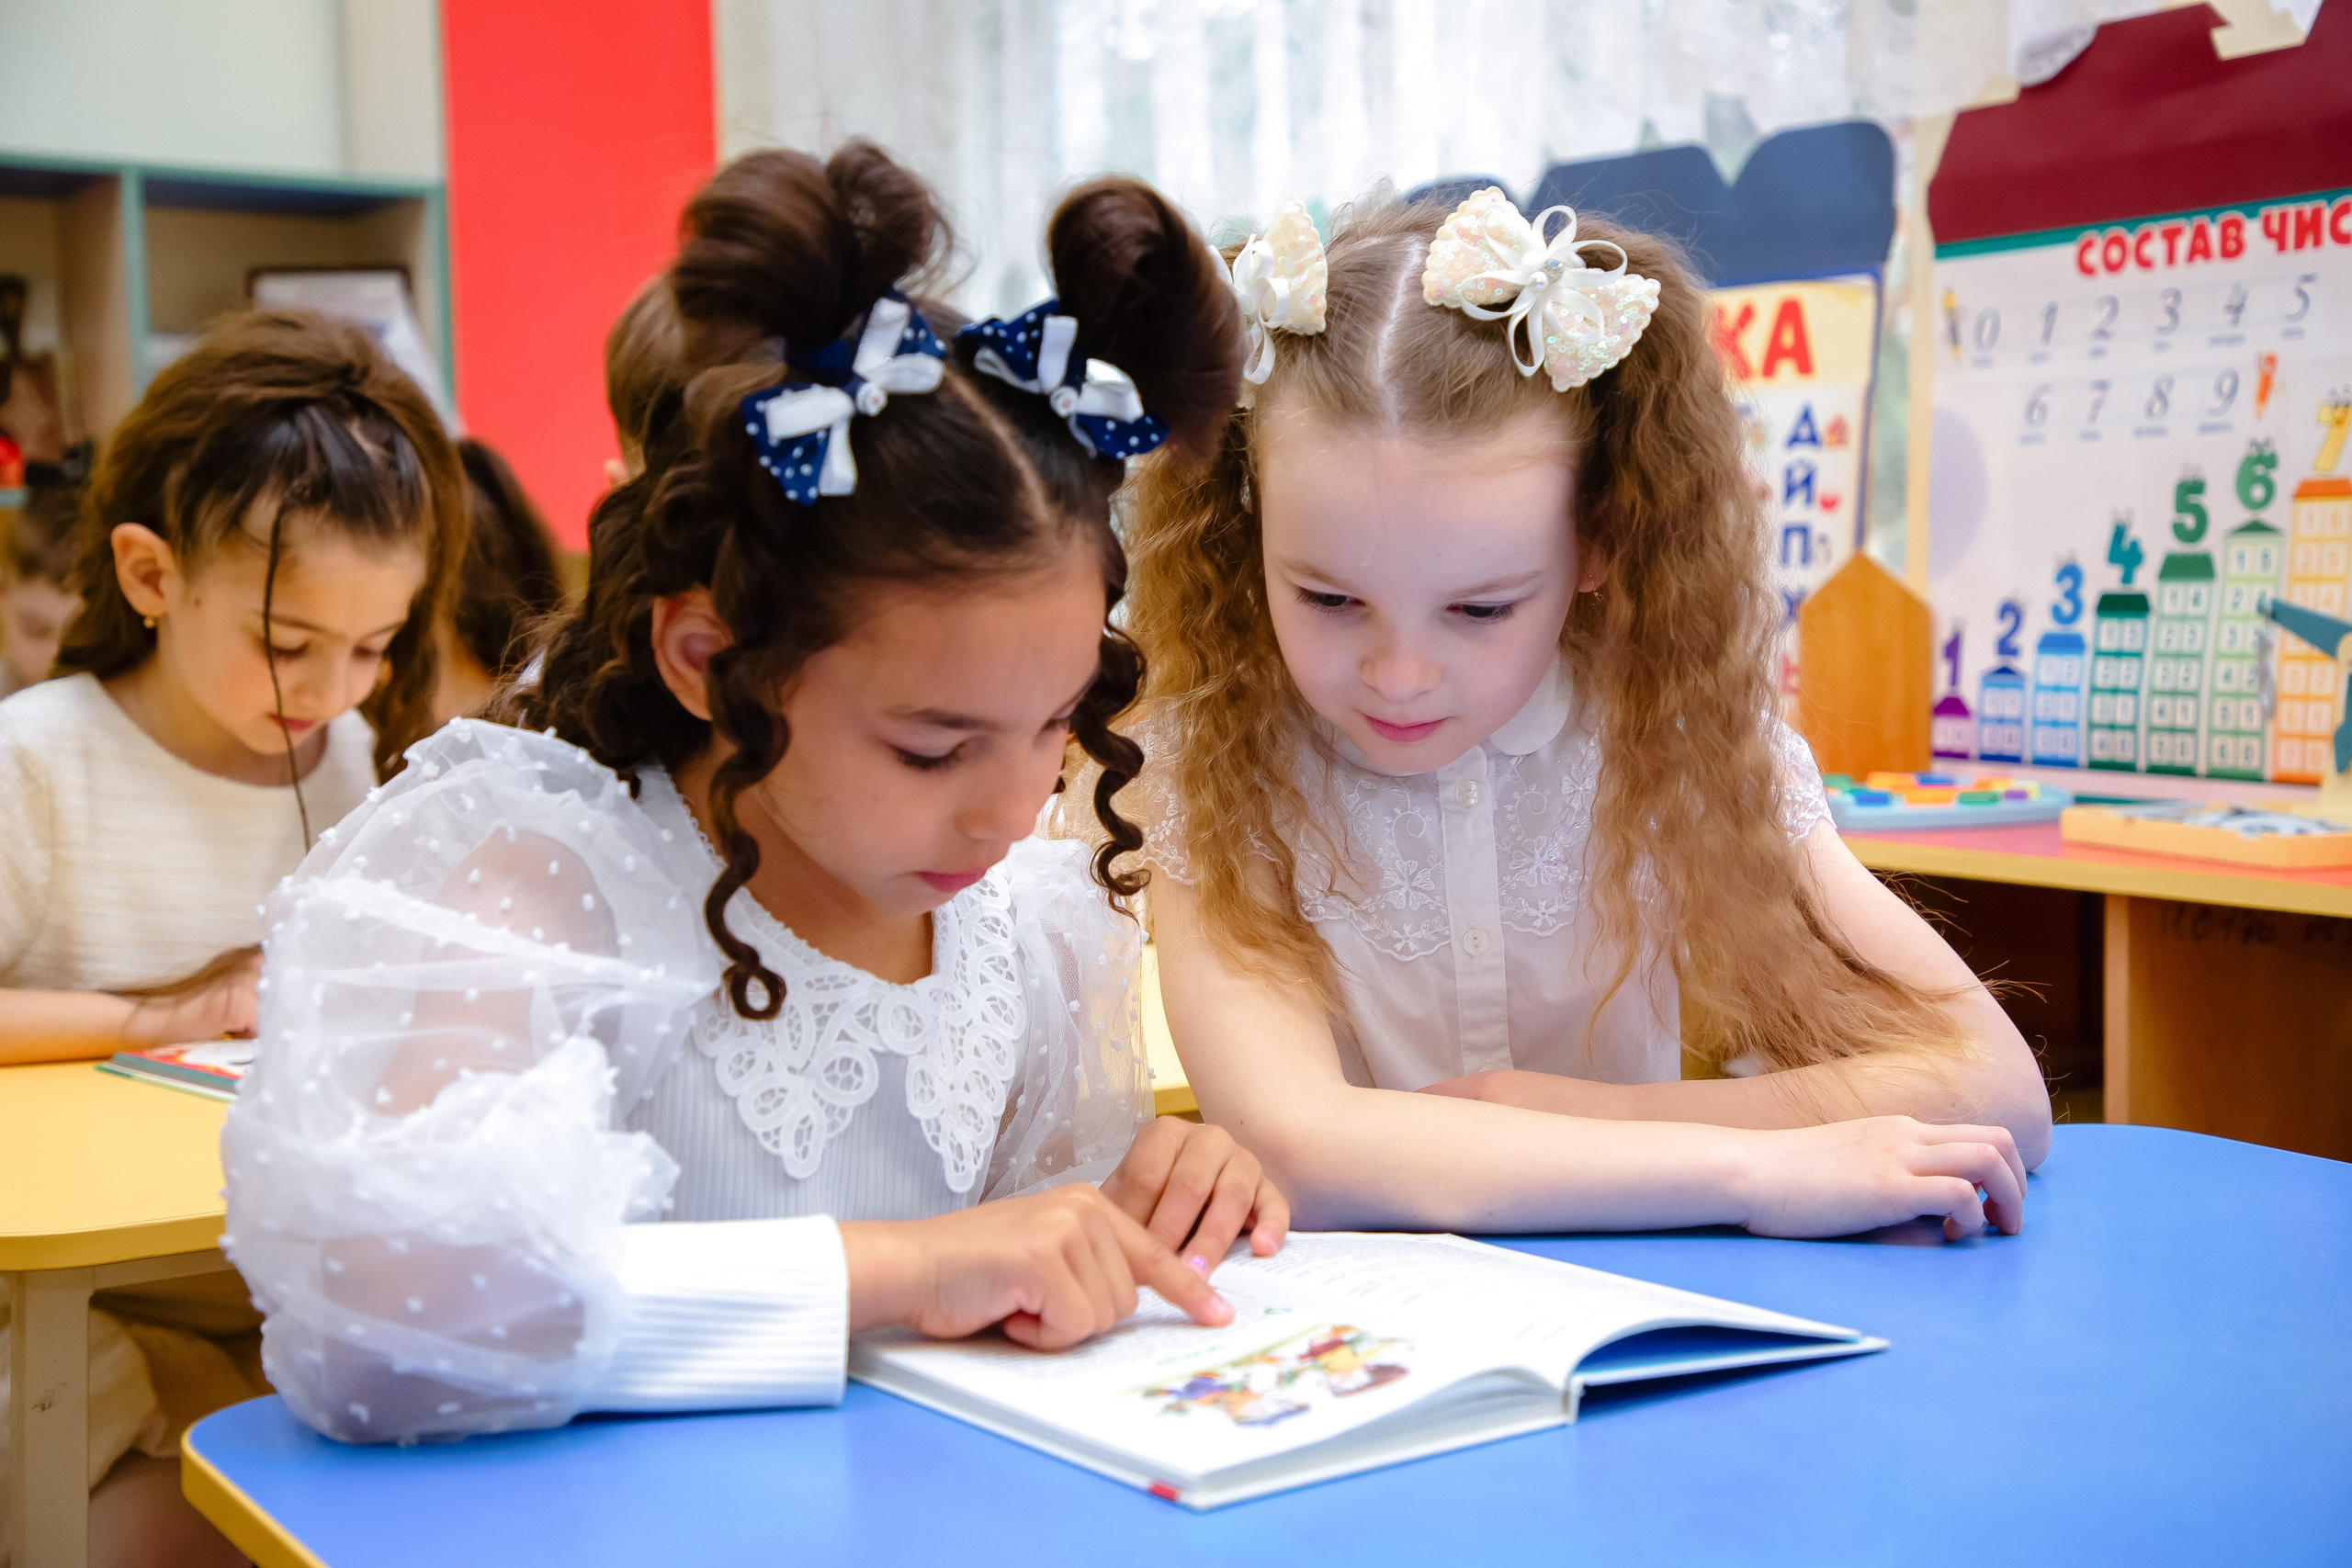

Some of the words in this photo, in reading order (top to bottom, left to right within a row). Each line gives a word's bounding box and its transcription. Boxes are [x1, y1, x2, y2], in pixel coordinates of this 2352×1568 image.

[2075, 216, 2245, 276] СОСТАВ
[2261, 199, 2352, 253] ЧИС
[1973, 306, 2001, 352] 0
[2041, 300, 2059, 345] 1
[2094, 294, 2120, 342] 2
[2156, 288, 2183, 336] 3
[2222, 279, 2248, 329] 4
[2284, 273, 2319, 324] 5
[1784, 403, 1820, 448] Д
[2023, 382, 2052, 429] 6
[2088, 378, 2111, 425] 7
[2143, 372, 2175, 422] 8
[2206, 367, 2239, 418] 9
[2314, 404, 2352, 469] 7
[1782, 460, 1815, 507] Й
[2172, 479, 2210, 544] 5
[2235, 450, 2278, 511] 6
[1781, 523, 1812, 567] П
[2108, 522, 2143, 585] 4
[2052, 563, 2084, 626] 3
[1942, 630, 1962, 689] 1
[1996, 601, 2022, 658] 2
